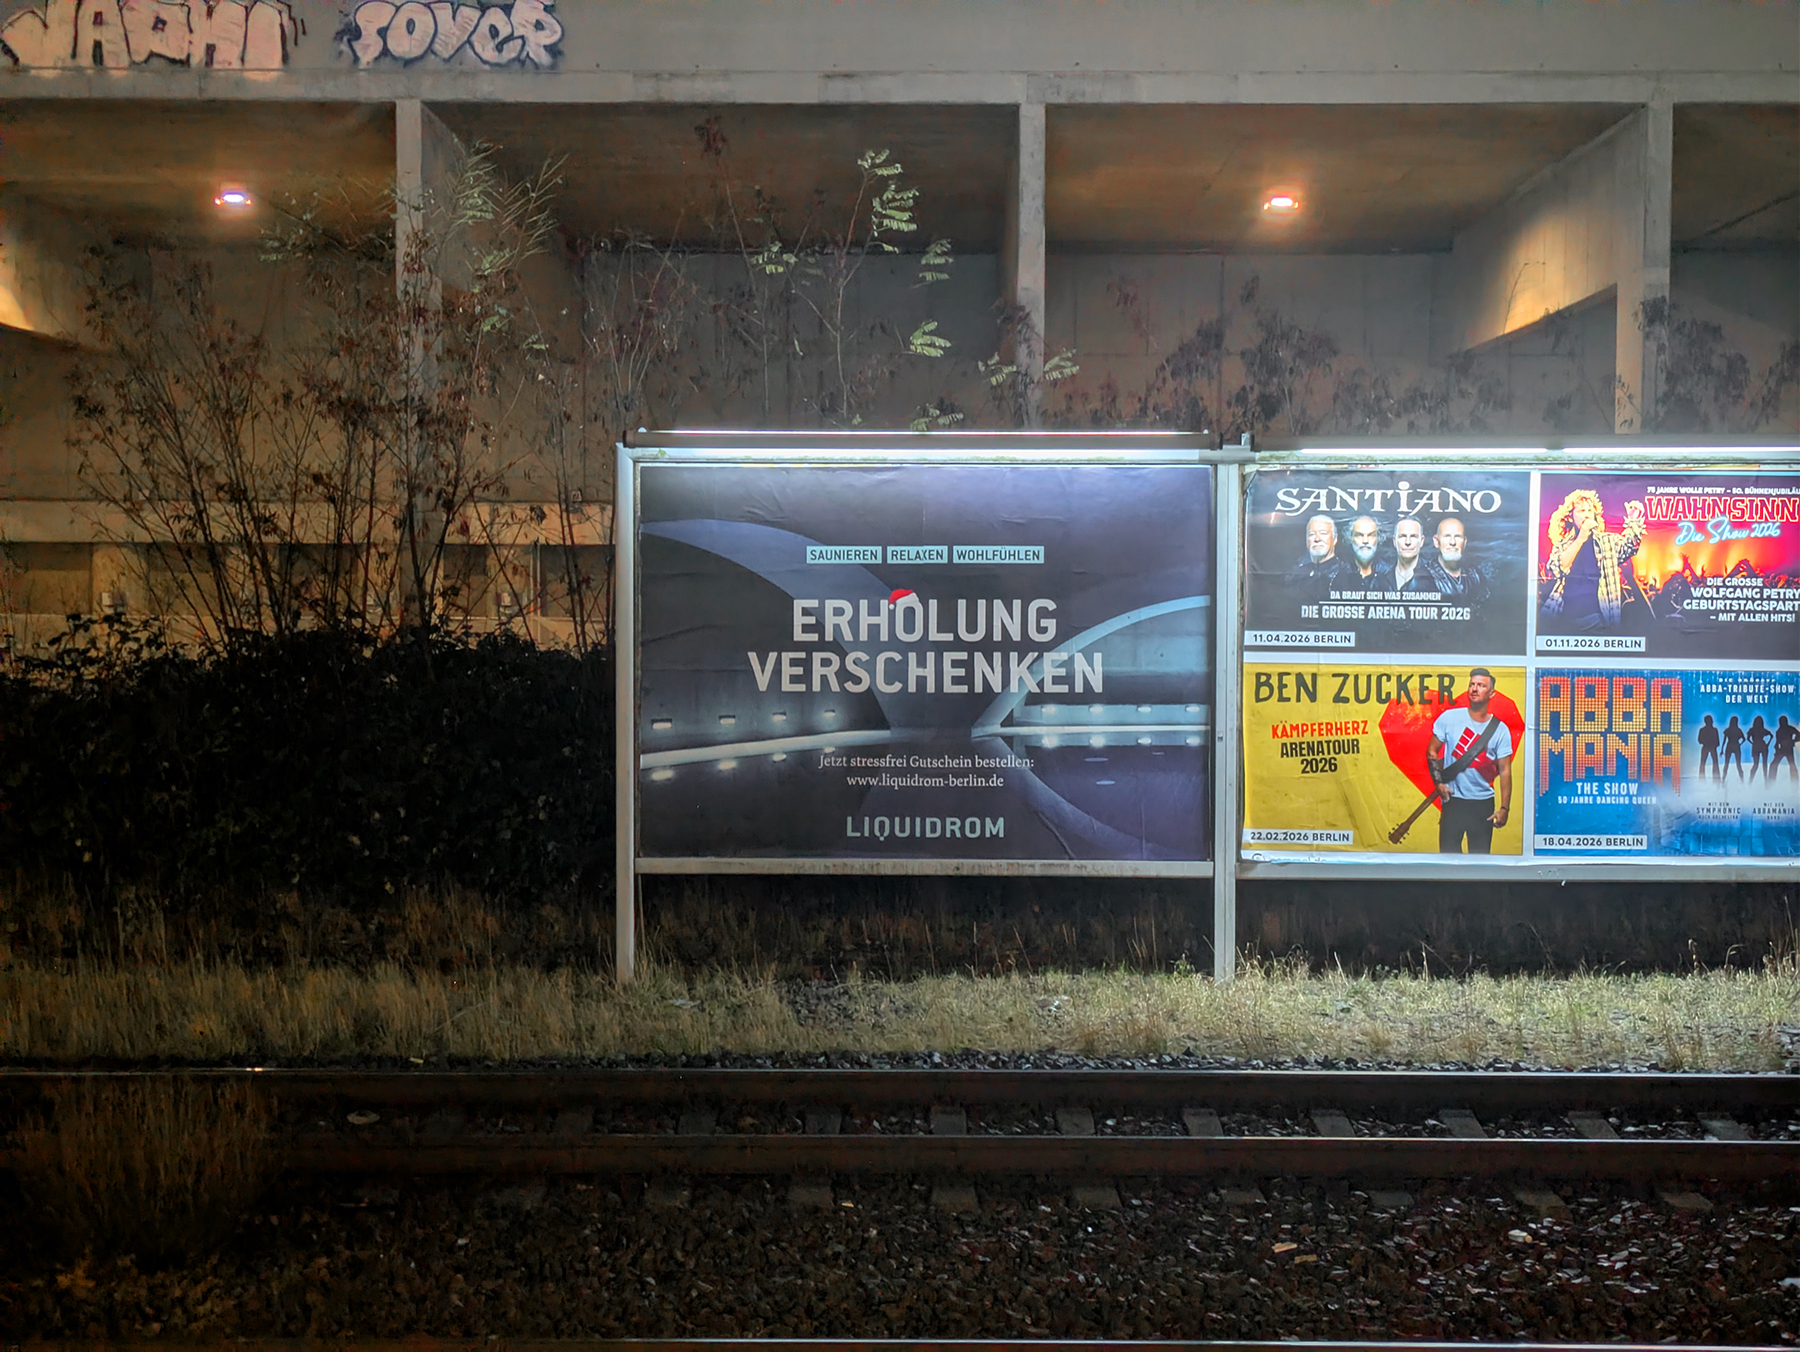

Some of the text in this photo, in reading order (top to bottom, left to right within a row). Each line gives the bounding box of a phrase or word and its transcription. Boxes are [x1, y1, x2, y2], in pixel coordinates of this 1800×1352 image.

[1679, 486, 1703, 494] WOLLE
[1703, 486, 1726, 494] PETRY
[1275, 481, 1502, 517] SANTIANO
[1645, 495, 1800, 522] WAHNSINN
[1674, 515, 1782, 546] Die Show 2026
[810, 547, 1041, 561] SAUNIEREN RELAXEN WOHLFÜHLEN
[1706, 577, 1764, 587] DIE GROSSE
[1330, 590, 1442, 601] DA BRAUT SICH WAS ZUSAMMEN
[1690, 587, 1800, 599] WOLFGANG PETRY
[1301, 604, 1471, 620] DIE GROSSE ARENA TOUR 2026
[1682, 599, 1800, 611] GEBURTSTAGSPART
[792, 598, 1058, 643] ERHOLUNG
[1718, 612, 1736, 622] MIT
[1738, 613, 1769, 622] ALLEN
[1770, 613, 1796, 623] HITS!
[1253, 634, 1351, 644] 11.04.2026 BERLIN
[1545, 638, 1642, 648] 01.11.2026 BERLIN
[747, 651, 1104, 694] VERSCHENKEN
[1254, 671, 1457, 706] BEN ZUCKER
[1700, 684, 1795, 694] ABBA-TRIBUTE-SHOW
[1539, 676, 1683, 733] ABBA
[1725, 694, 1769, 704] DER WELT
[1271, 720, 1369, 739] KÄMPFERHERZ
[1280, 738, 1360, 759] ARENATOUR
[818, 754, 1035, 769] Jetzt stressfrei Gutschein bestellen:
[1300, 756, 1339, 774] 2026
[1539, 733, 1683, 798] MANIA
[847, 773, 1005, 790] www.liquidrom-berlin.de
[1576, 782, 1639, 796] THE SHOW
[1557, 795, 1568, 804] 50
[1570, 796, 1594, 804] JAHRE
[1596, 796, 1630, 805] DANCING
[1696, 807, 1742, 815] SYMPHONIC
[846, 816, 1006, 841] LIQUIDROM
[1250, 831, 1350, 842] 22.02.2026 BERLIN
[1542, 837, 1644, 846] 18.04.2026 BERLIN
